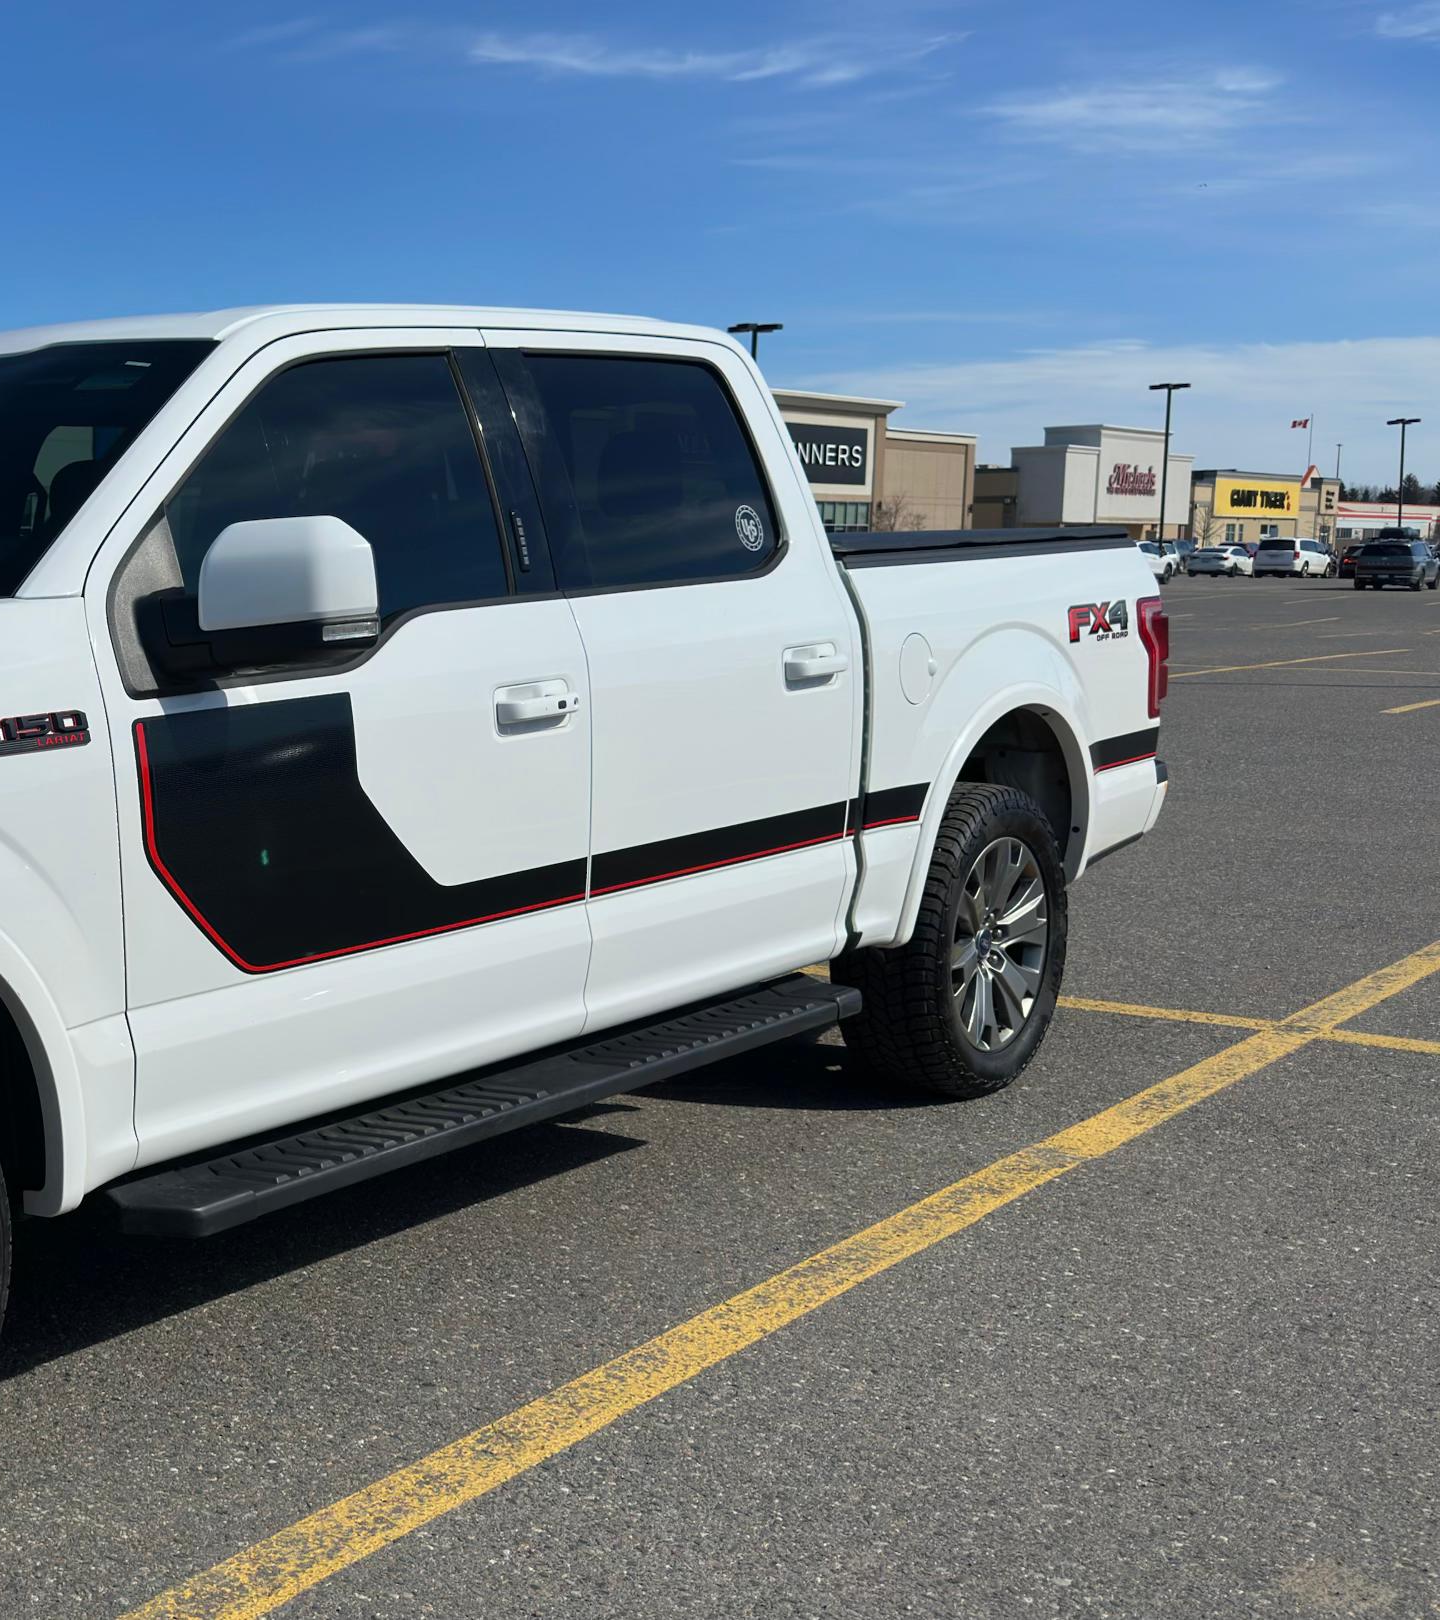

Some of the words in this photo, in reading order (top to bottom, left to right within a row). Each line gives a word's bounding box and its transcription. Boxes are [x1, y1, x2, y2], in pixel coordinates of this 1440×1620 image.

[1108, 463, 1156, 487] Michaels
[1230, 489, 1258, 508] GIANT
[1260, 490, 1285, 509] TIGER
[1068, 600, 1128, 643] FX4
[1111, 631, 1128, 639] ROAD
[37, 732, 86, 747] LARIAT
